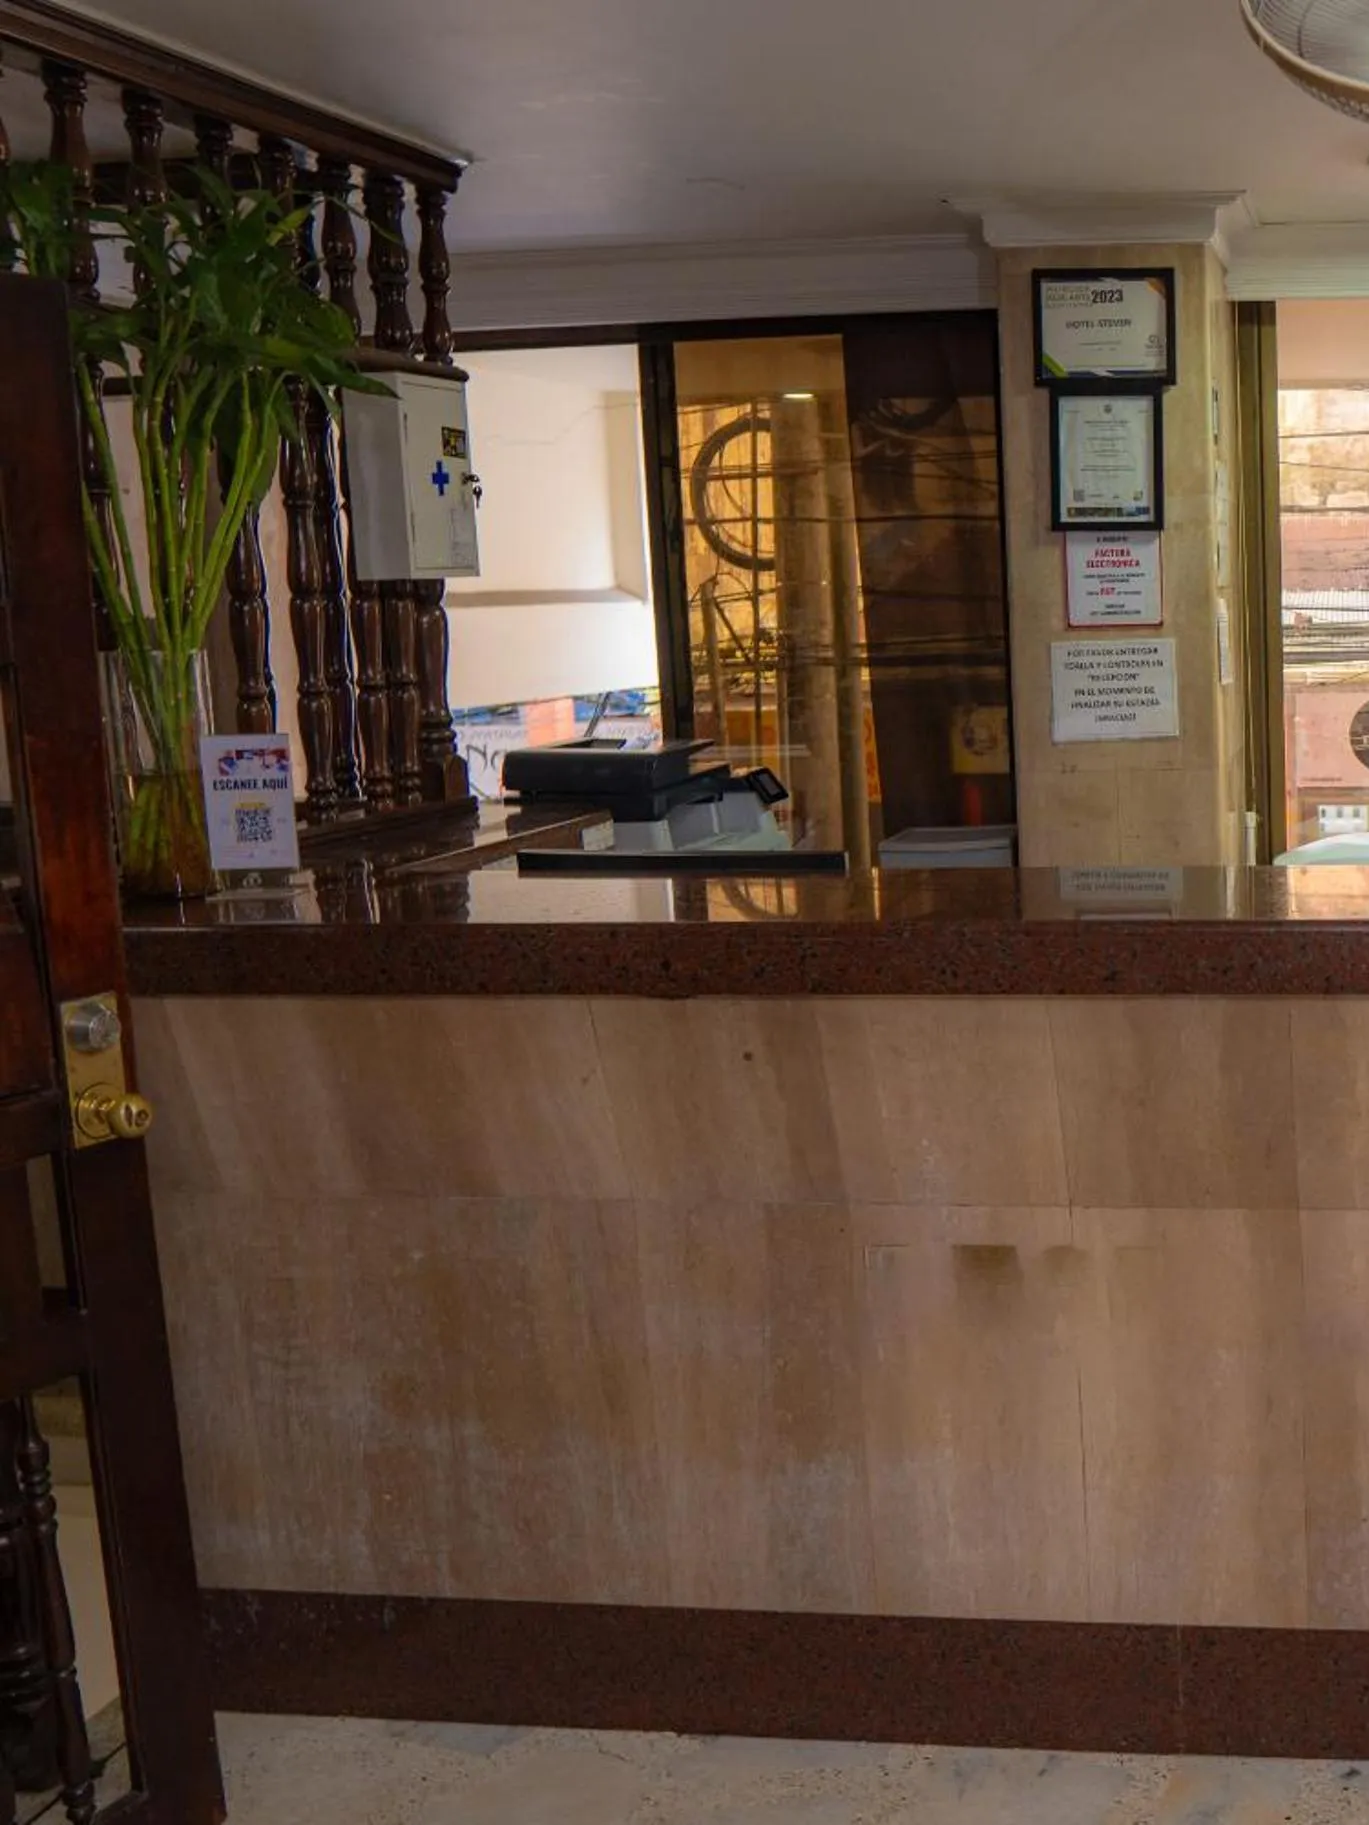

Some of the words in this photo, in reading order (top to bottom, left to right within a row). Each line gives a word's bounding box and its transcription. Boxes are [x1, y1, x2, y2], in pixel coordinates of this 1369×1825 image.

[1091, 289, 1124, 304] 2023
[1066, 320, 1095, 329] HOTEL
[1098, 318, 1132, 328] STEVEN
[1095, 548, 1131, 557] FACTURA
[1074, 688, 1085, 697] EN
[1087, 688, 1096, 697] EL
[1143, 685, 1155, 695] DE
[213, 779, 258, 791] ESCANEE
